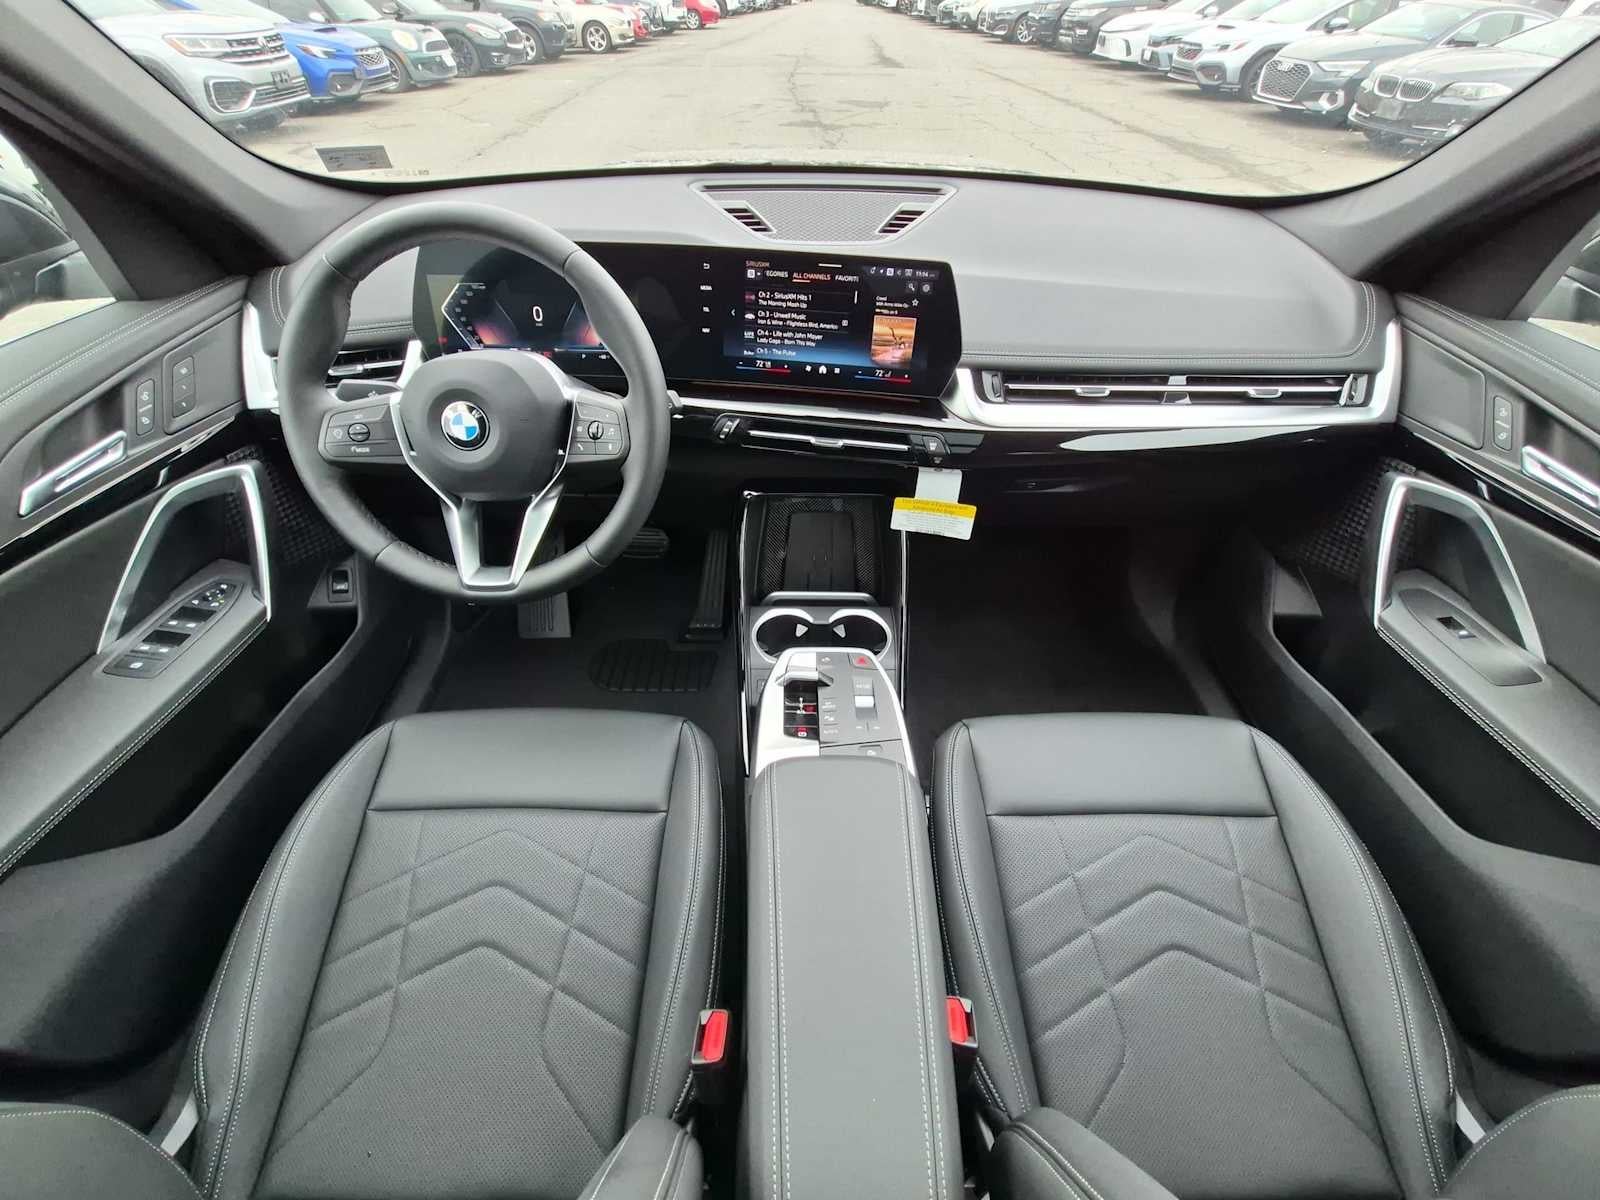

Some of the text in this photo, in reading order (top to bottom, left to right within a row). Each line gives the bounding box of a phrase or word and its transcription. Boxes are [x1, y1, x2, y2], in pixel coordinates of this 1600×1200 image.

[803, 273, 832, 281] CHANNELS
[758, 291, 766, 299] Ch
[774, 292, 797, 300] SiriusXM
[768, 300, 786, 308] Morning
[532, 305, 544, 322] 0
[773, 311, 791, 319] Unwell
[791, 312, 807, 320] Music
[794, 331, 806, 339] John
[807, 332, 823, 341] Mayer
[757, 337, 769, 345] Lady
